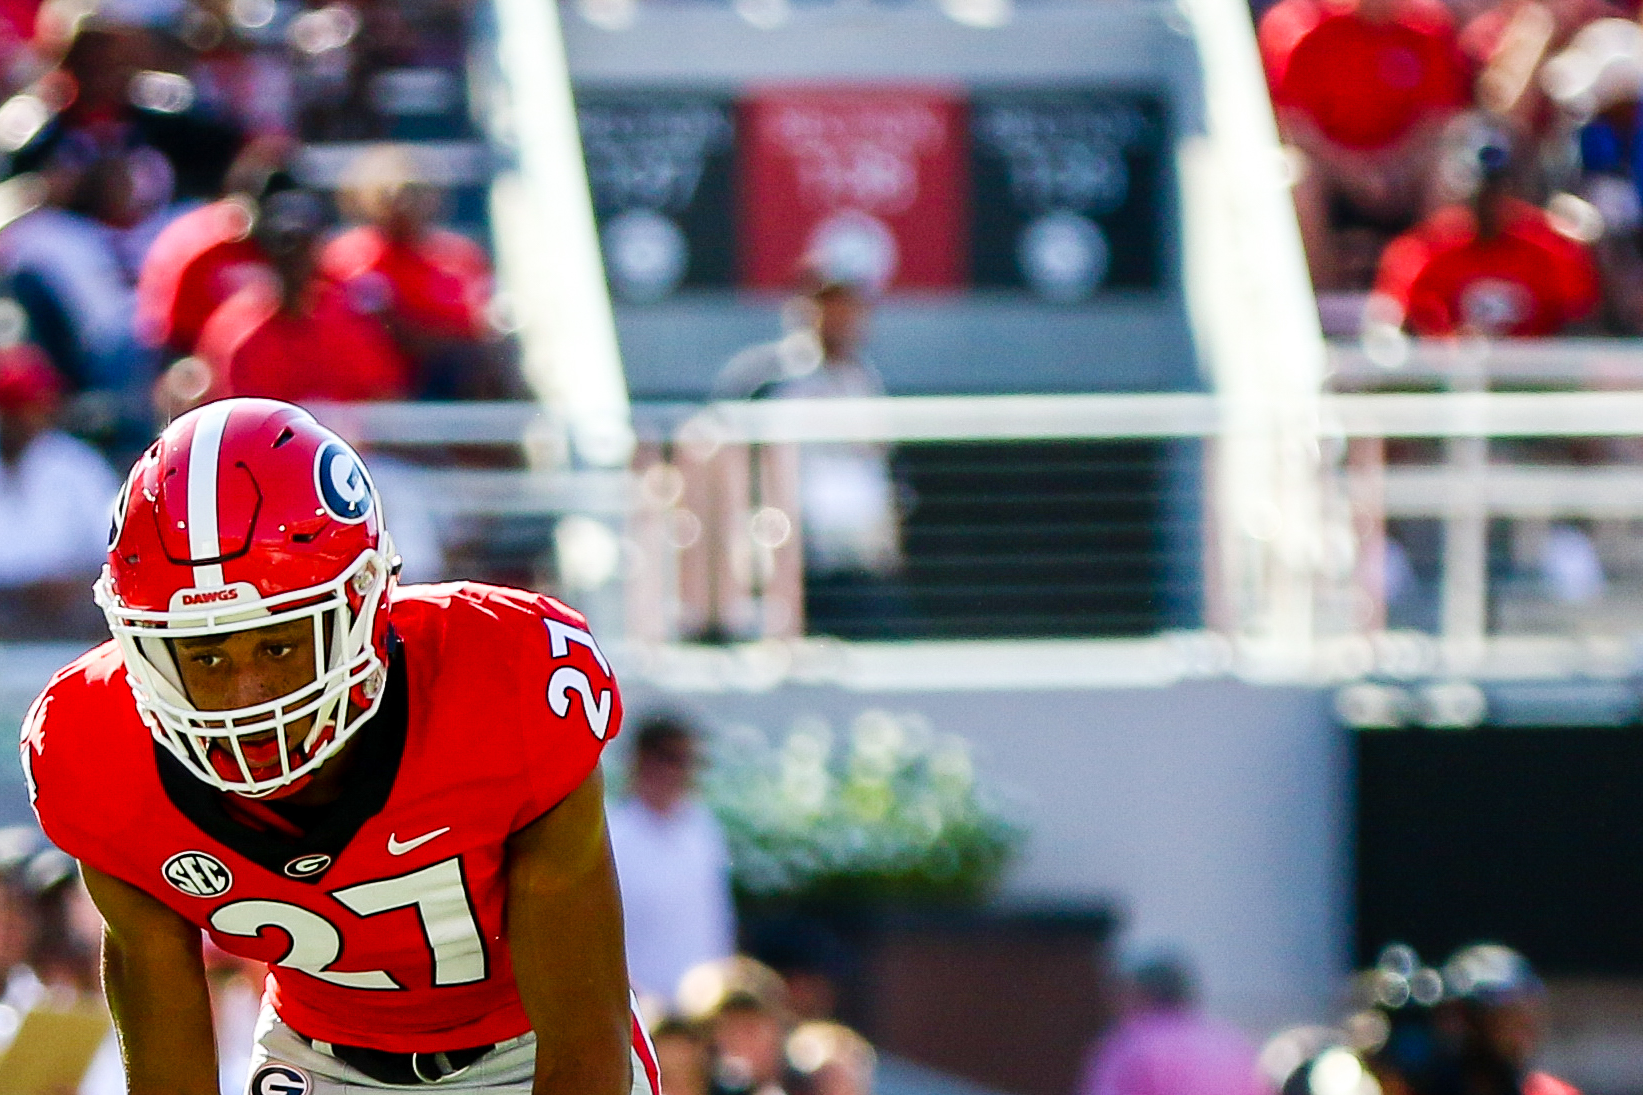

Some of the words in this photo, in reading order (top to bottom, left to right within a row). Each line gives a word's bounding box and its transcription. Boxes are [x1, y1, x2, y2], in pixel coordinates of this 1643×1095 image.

[182, 588, 238, 605] DAWGS
[542, 617, 615, 742] 27
[168, 857, 227, 895] SEC
[208, 855, 490, 991] 27
